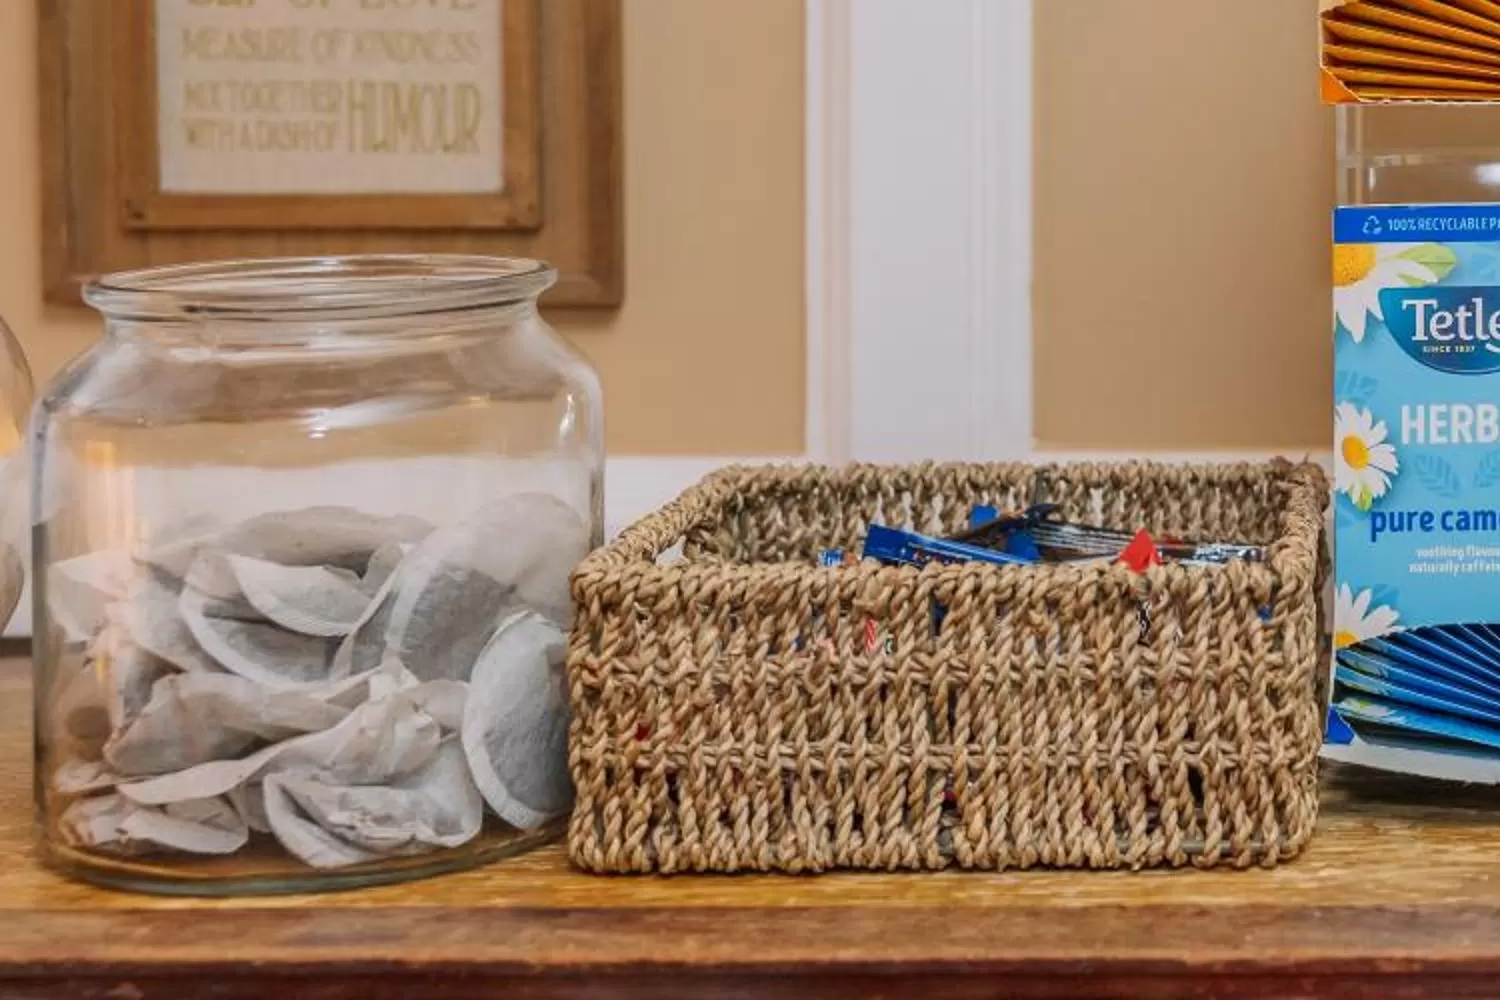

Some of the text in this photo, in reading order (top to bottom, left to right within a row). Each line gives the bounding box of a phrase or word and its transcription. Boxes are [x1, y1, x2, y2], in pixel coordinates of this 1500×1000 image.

[1388, 217, 1417, 232] 100%
[1418, 215, 1488, 232] RECYCLABLE
[1423, 345, 1451, 353] SINCE
[1371, 508, 1433, 543] pure
